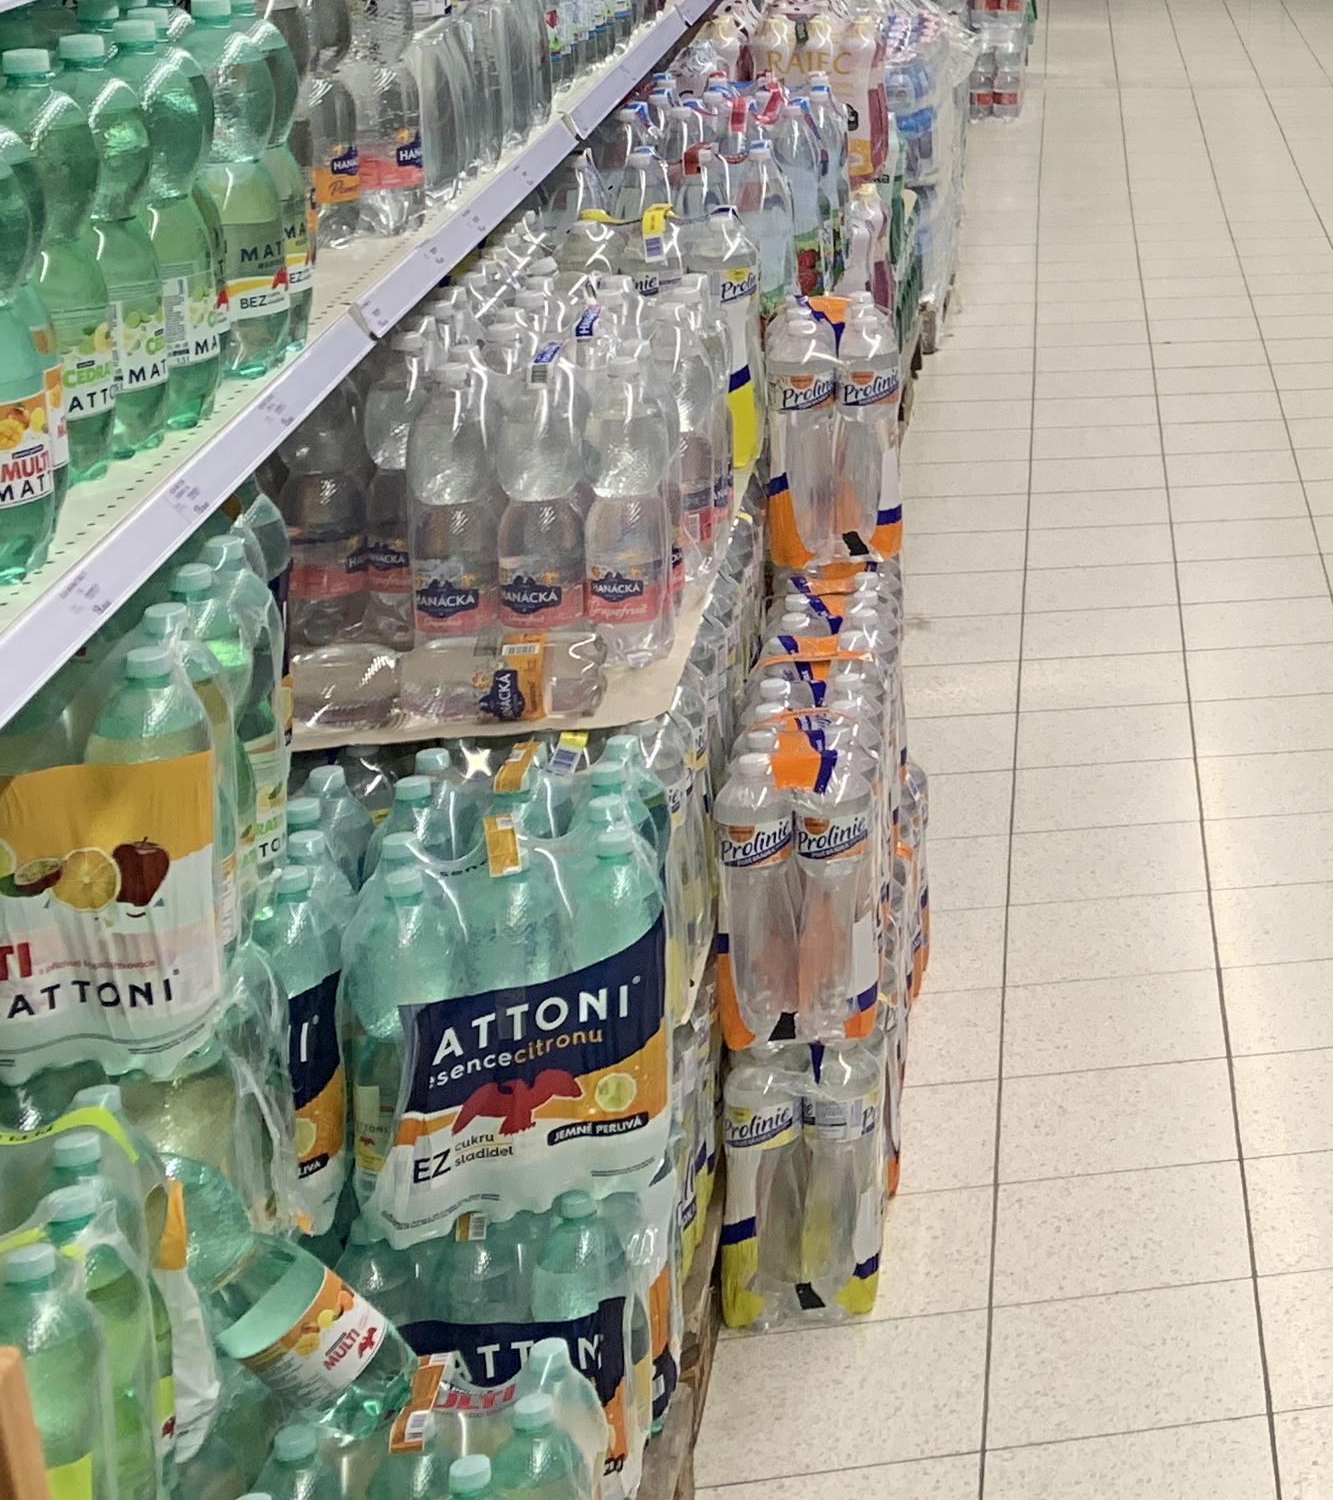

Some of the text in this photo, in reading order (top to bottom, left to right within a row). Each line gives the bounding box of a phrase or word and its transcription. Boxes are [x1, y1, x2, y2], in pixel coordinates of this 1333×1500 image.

[240, 295, 268, 310] BEZ
[0, 942, 32, 981] TI
[7, 978, 174, 1020] ATTONI
[431, 984, 629, 1067] ATTONI
[454, 1132, 495, 1152] cukru
[412, 1148, 452, 1184] EZ
[322, 1327, 361, 1371] MULTI
